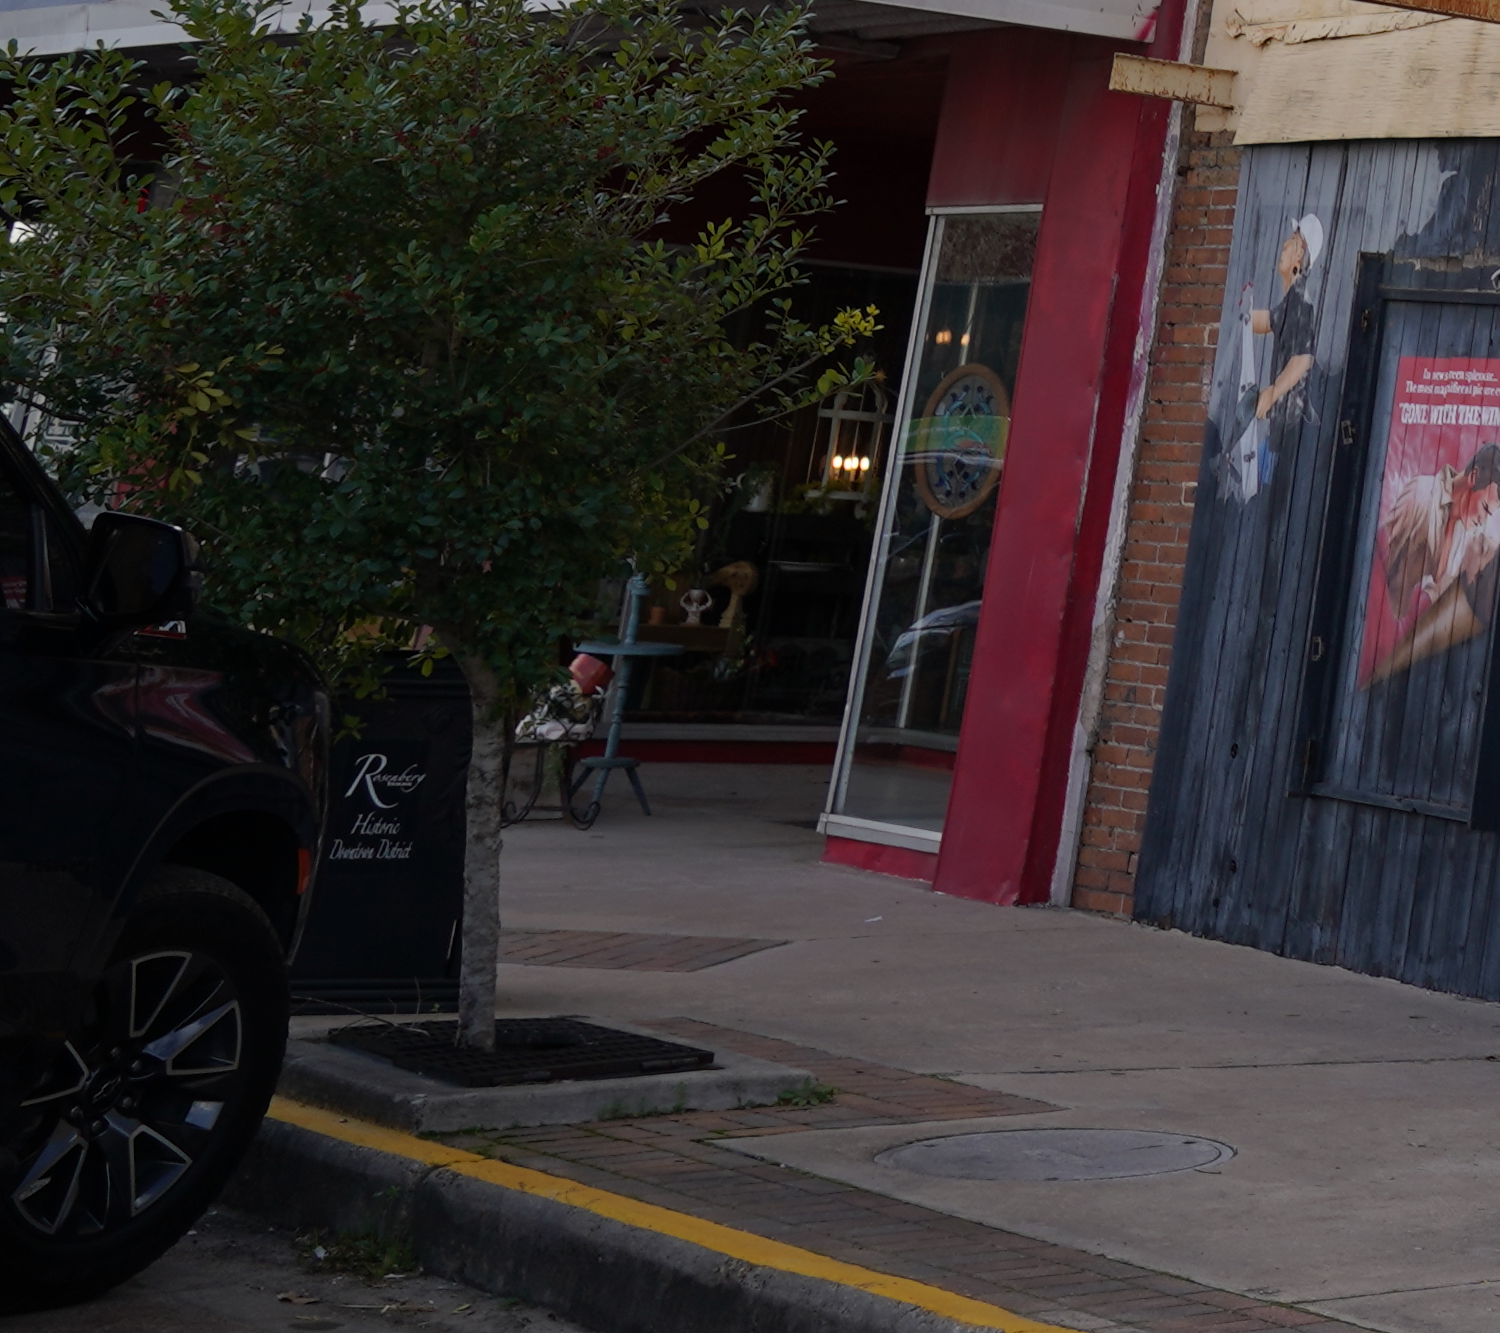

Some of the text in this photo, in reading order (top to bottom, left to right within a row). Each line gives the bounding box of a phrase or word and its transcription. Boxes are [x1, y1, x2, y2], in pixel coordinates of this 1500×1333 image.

[1405, 379, 1417, 394] The
[1472, 383, 1495, 398] picure
[1430, 403, 1457, 426] WITH
[1457, 404, 1481, 426] THE
